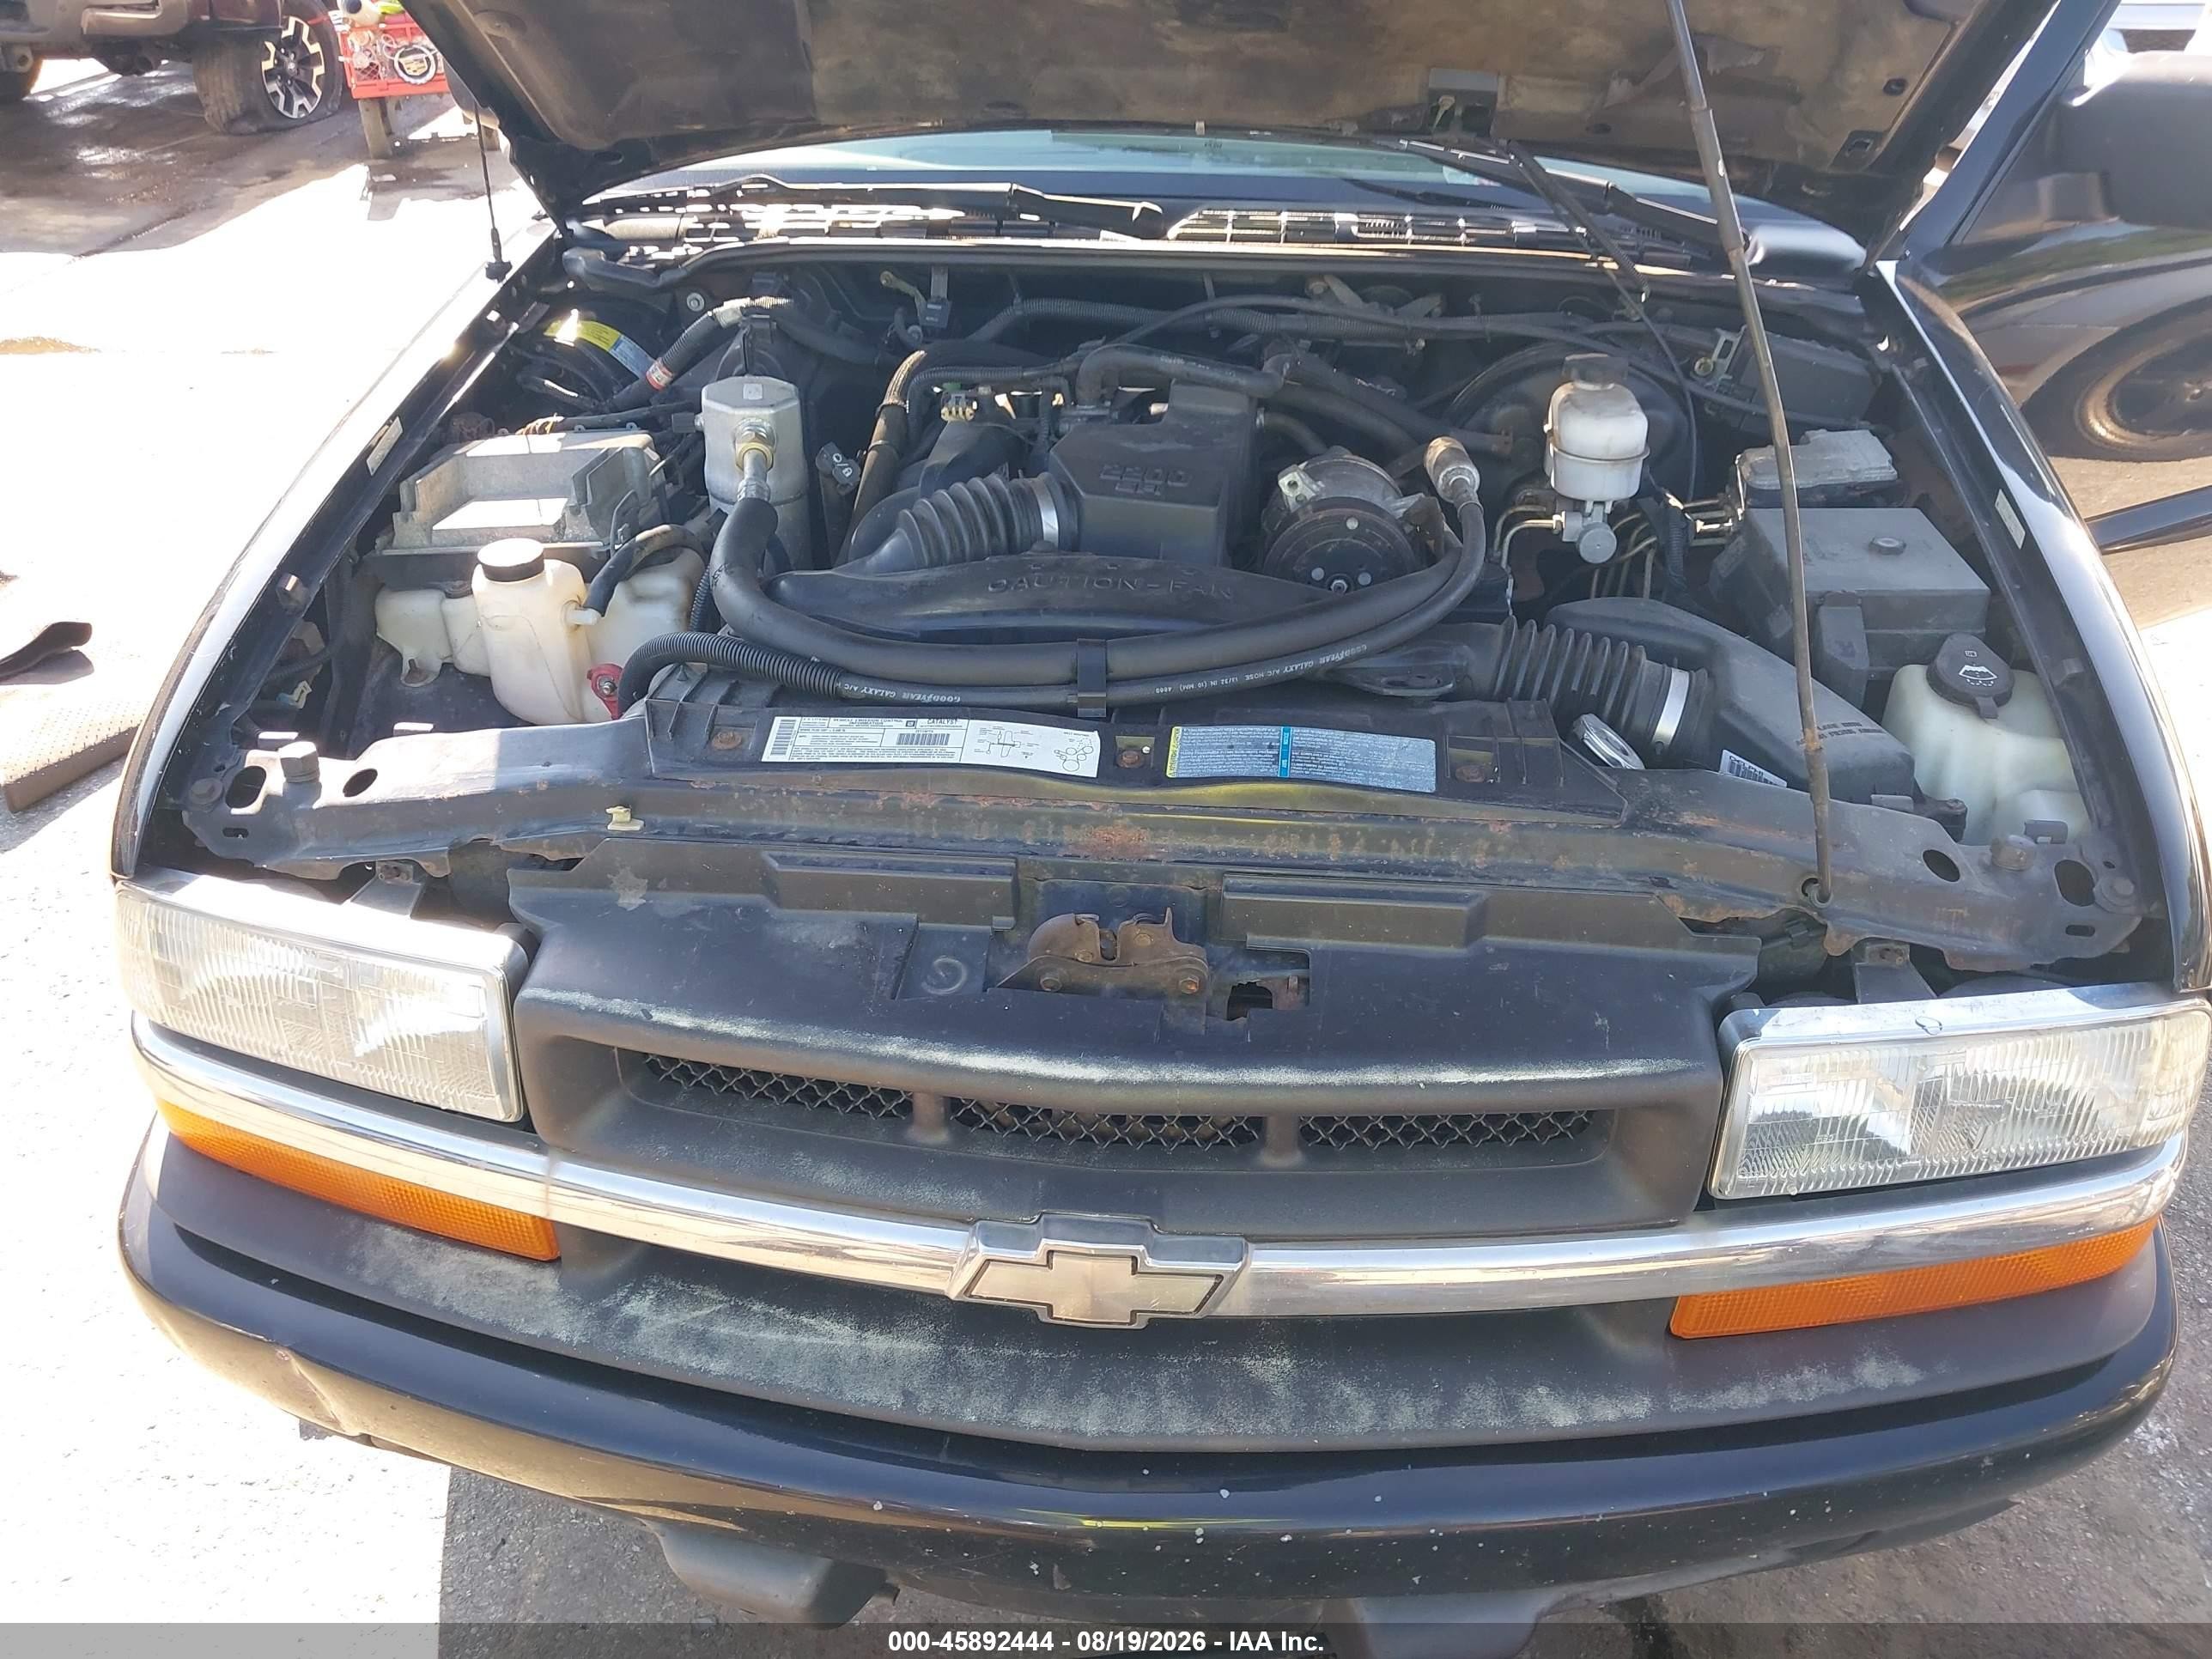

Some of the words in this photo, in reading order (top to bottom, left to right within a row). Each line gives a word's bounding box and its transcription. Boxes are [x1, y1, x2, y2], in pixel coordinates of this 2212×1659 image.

[988, 575, 1139, 592] CAUTION
[1319, 644, 1367, 665] GOODYEAR
[1283, 659, 1314, 674] GALAXY
[1243, 671, 1265, 681] HOSE
[1267, 668, 1280, 678] A/C
[844, 683, 859, 691] A/C
[860, 686, 896, 698] GALAXY
[902, 692, 961, 703] GOODYEAR
